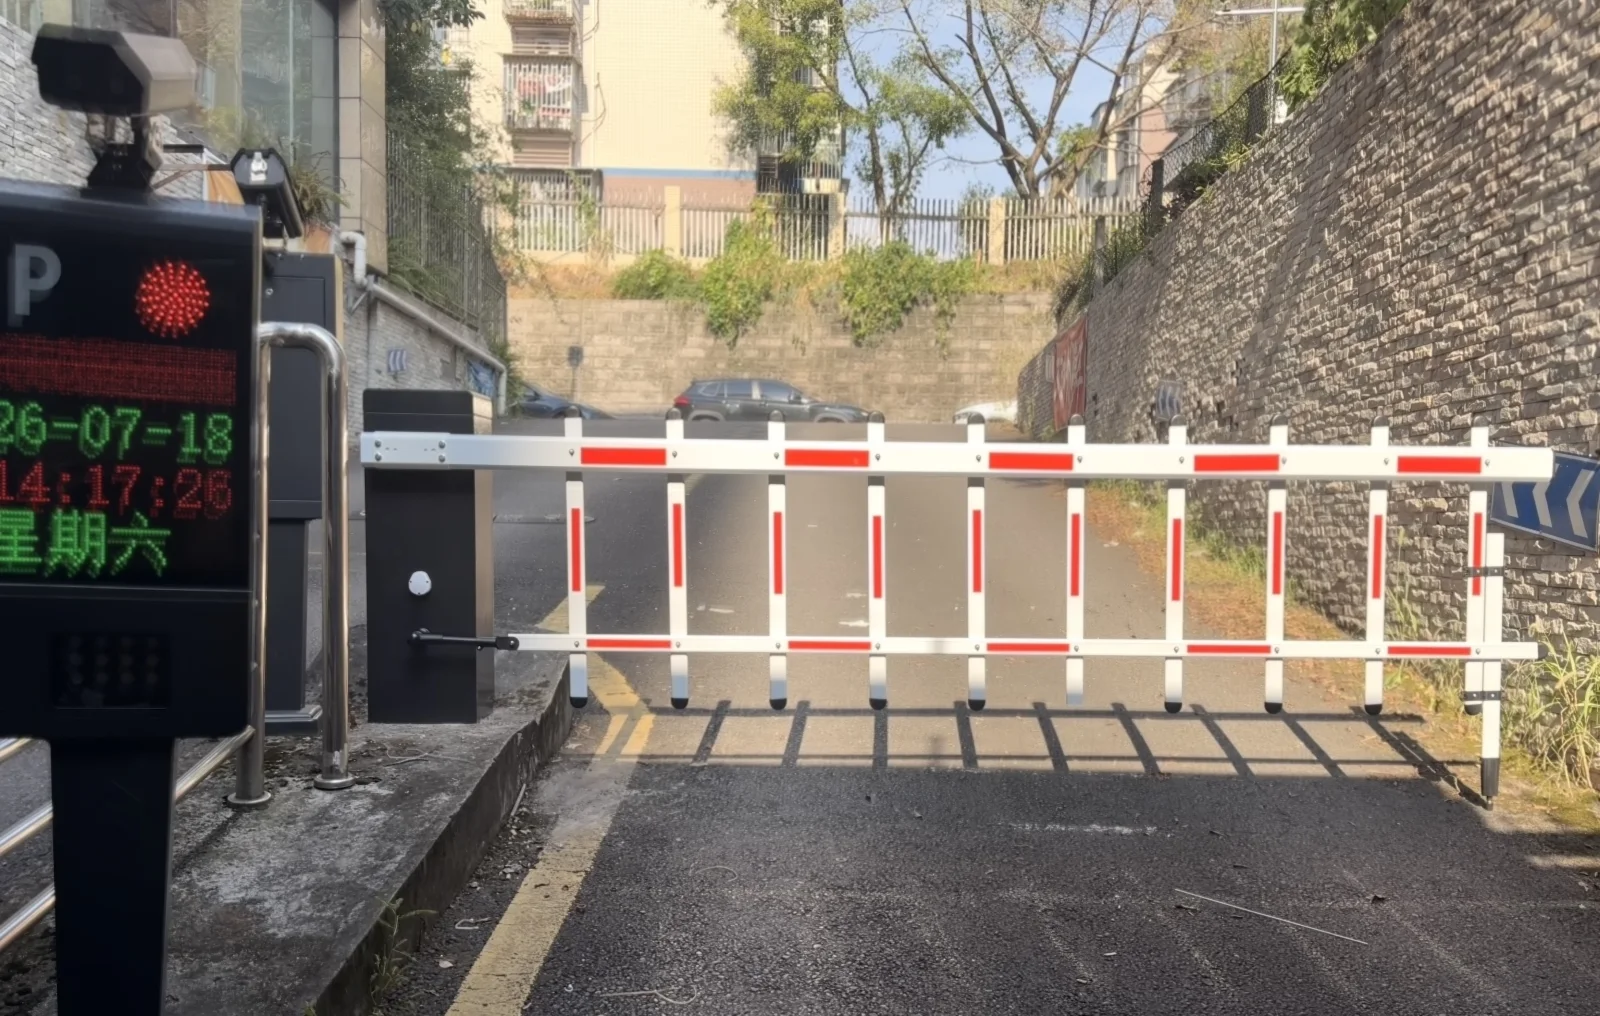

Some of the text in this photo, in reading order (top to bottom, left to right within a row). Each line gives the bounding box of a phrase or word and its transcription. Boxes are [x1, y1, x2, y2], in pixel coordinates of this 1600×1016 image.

[14, 243, 62, 317] P
[0, 507, 172, 573] 星期六
